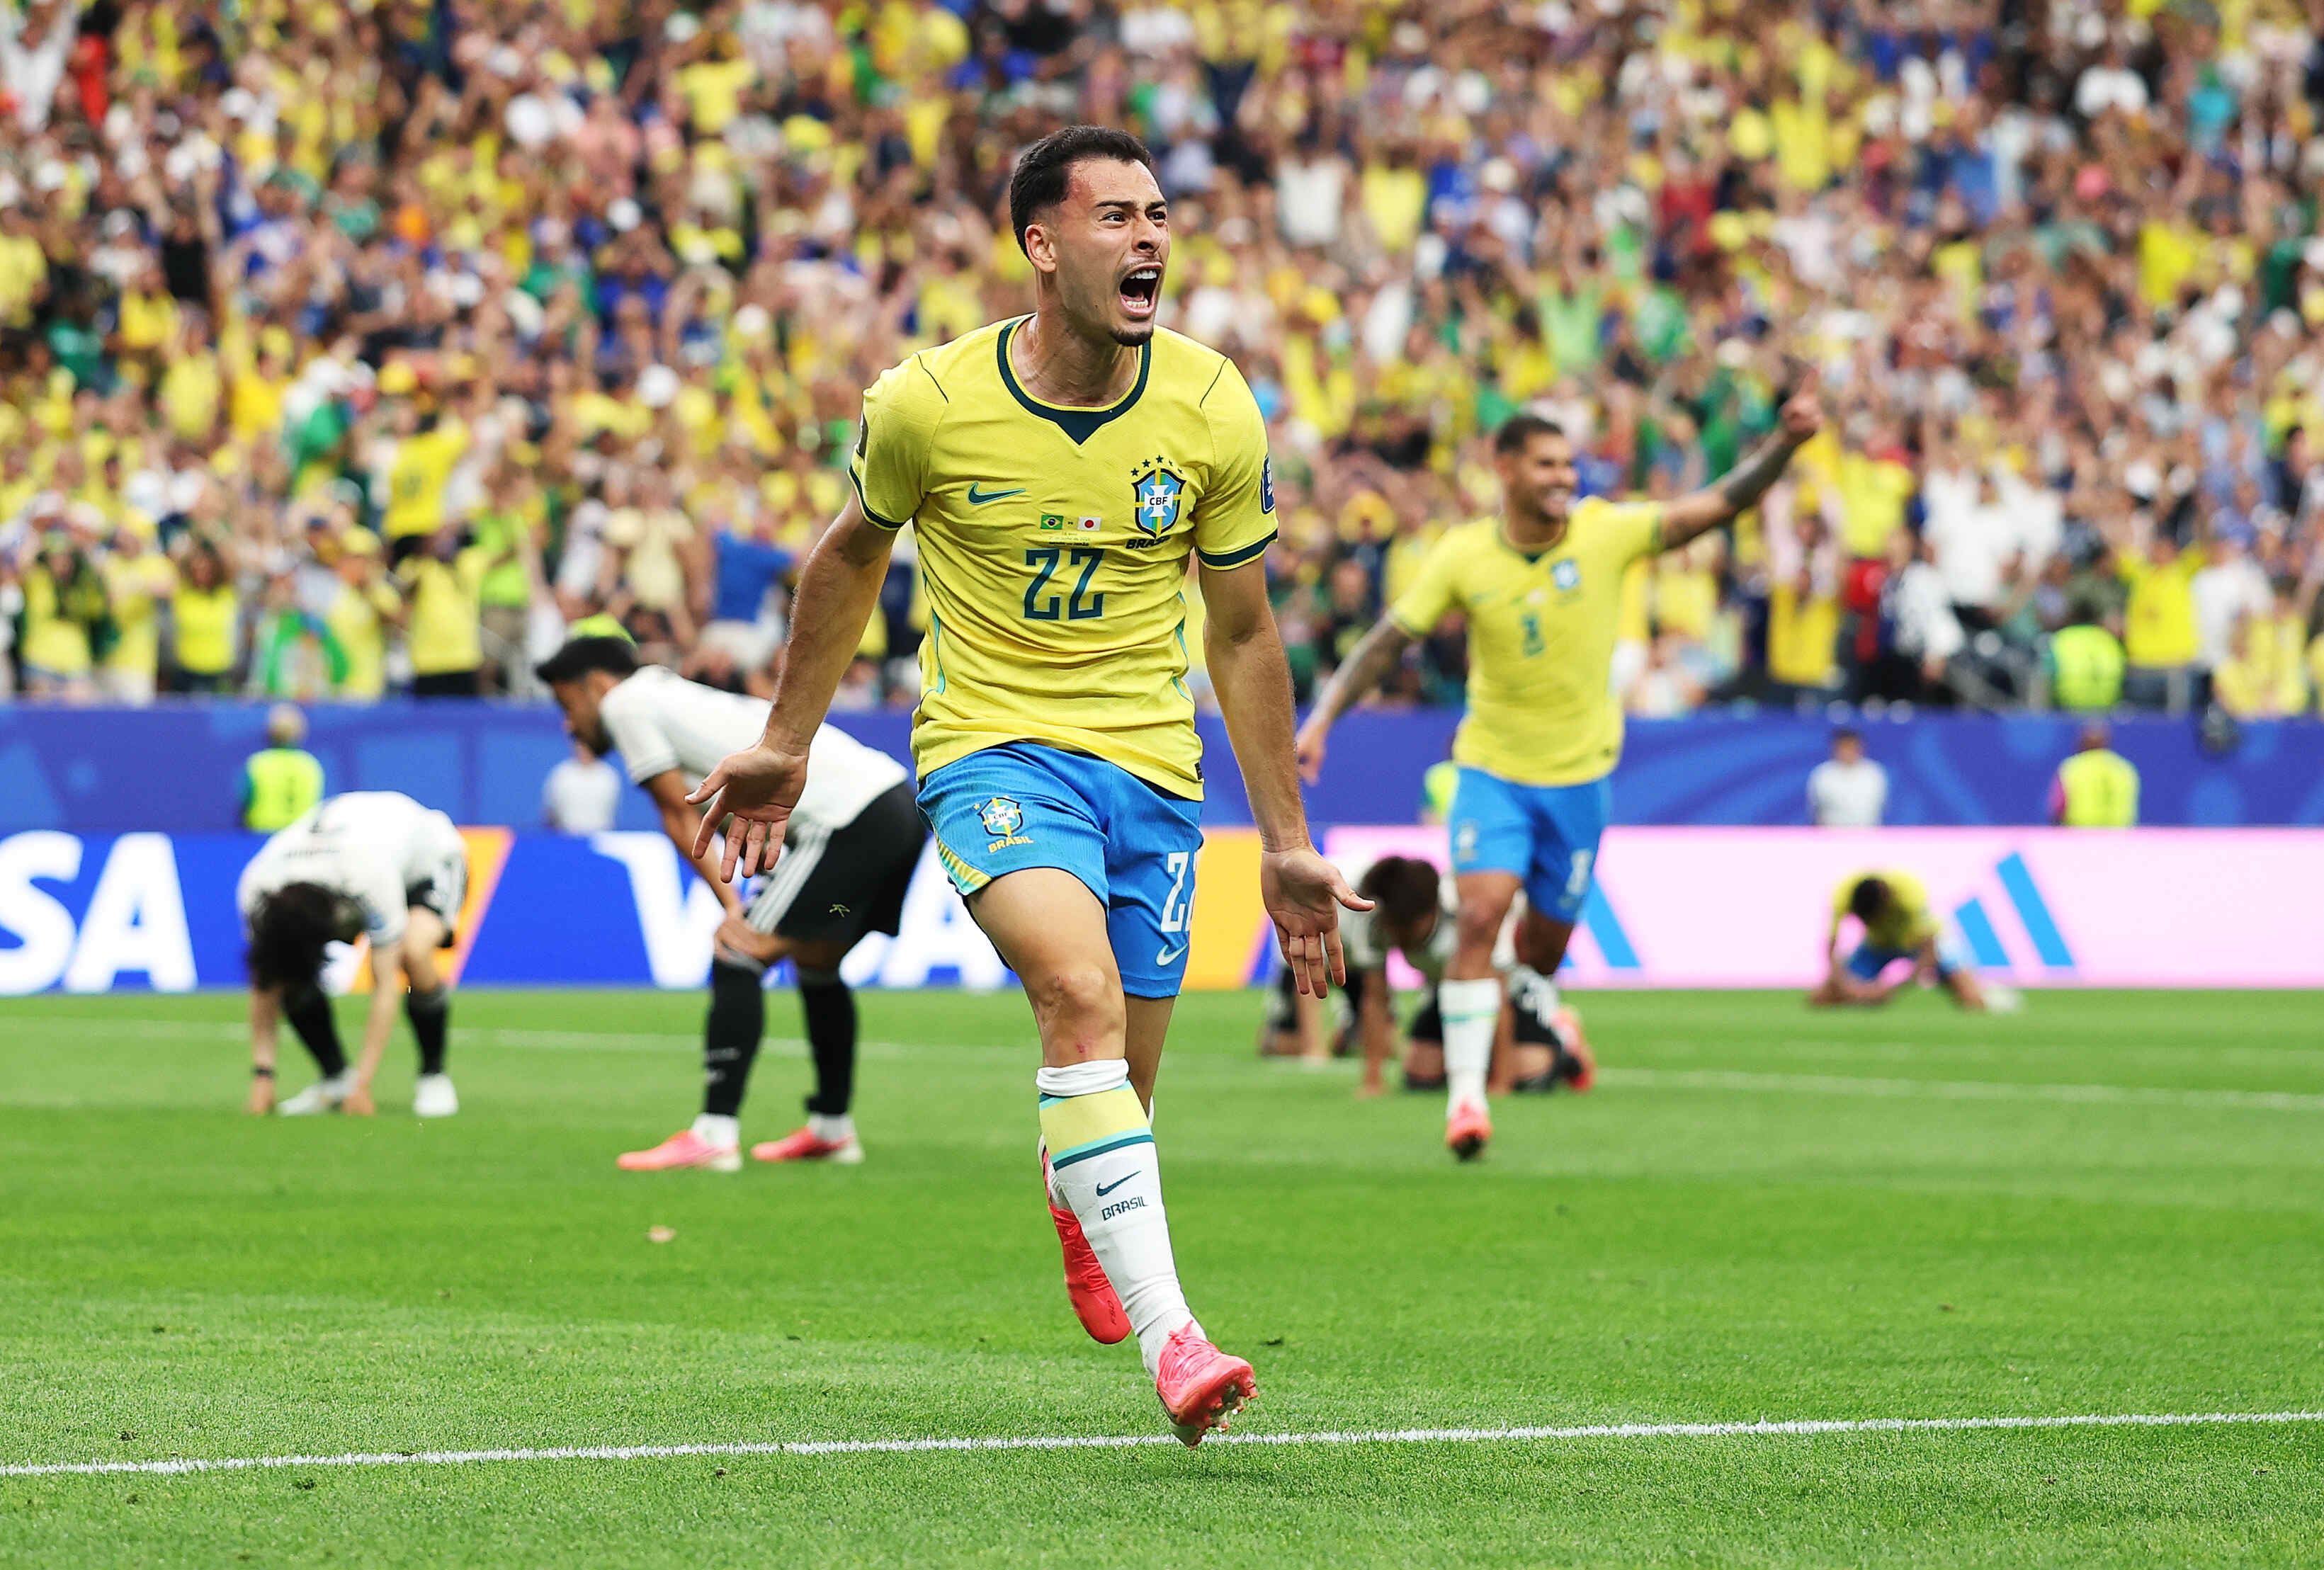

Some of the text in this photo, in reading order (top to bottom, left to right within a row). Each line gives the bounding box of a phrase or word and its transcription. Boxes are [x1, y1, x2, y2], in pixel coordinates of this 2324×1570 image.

[1149, 496, 1168, 506] CBF
[1024, 547, 1105, 620] 22
[988, 836, 1035, 853] BRASIL
[591, 831, 1014, 991] VA
[1101, 1196, 1148, 1221] BRASIL
